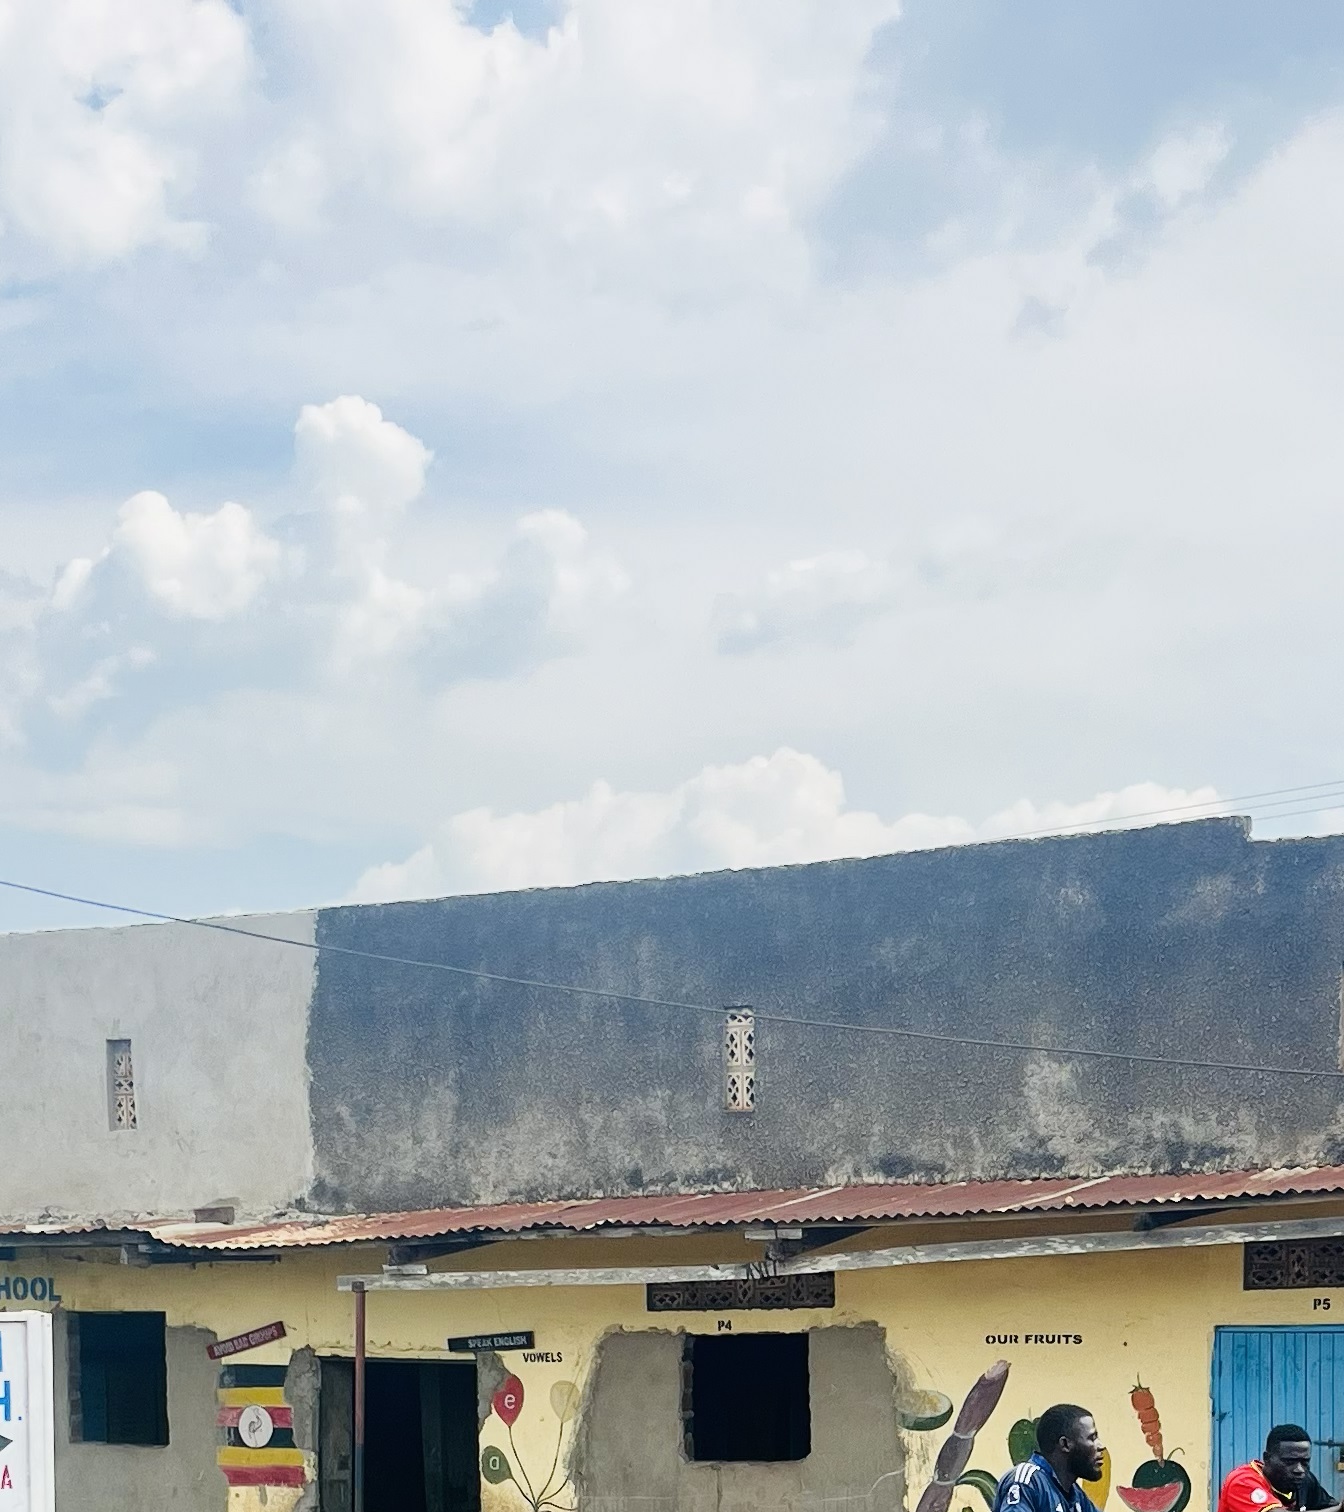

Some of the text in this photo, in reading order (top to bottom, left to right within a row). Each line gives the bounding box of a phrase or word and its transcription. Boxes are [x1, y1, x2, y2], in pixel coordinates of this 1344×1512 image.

[1313, 1298, 1331, 1311] P5
[717, 1319, 733, 1332] P4
[468, 1335, 528, 1349] SPEAK ENGLISH
[985, 1334, 1084, 1345] OUR FRUITS
[522, 1351, 564, 1364] VOWELS
[504, 1393, 516, 1410] e
